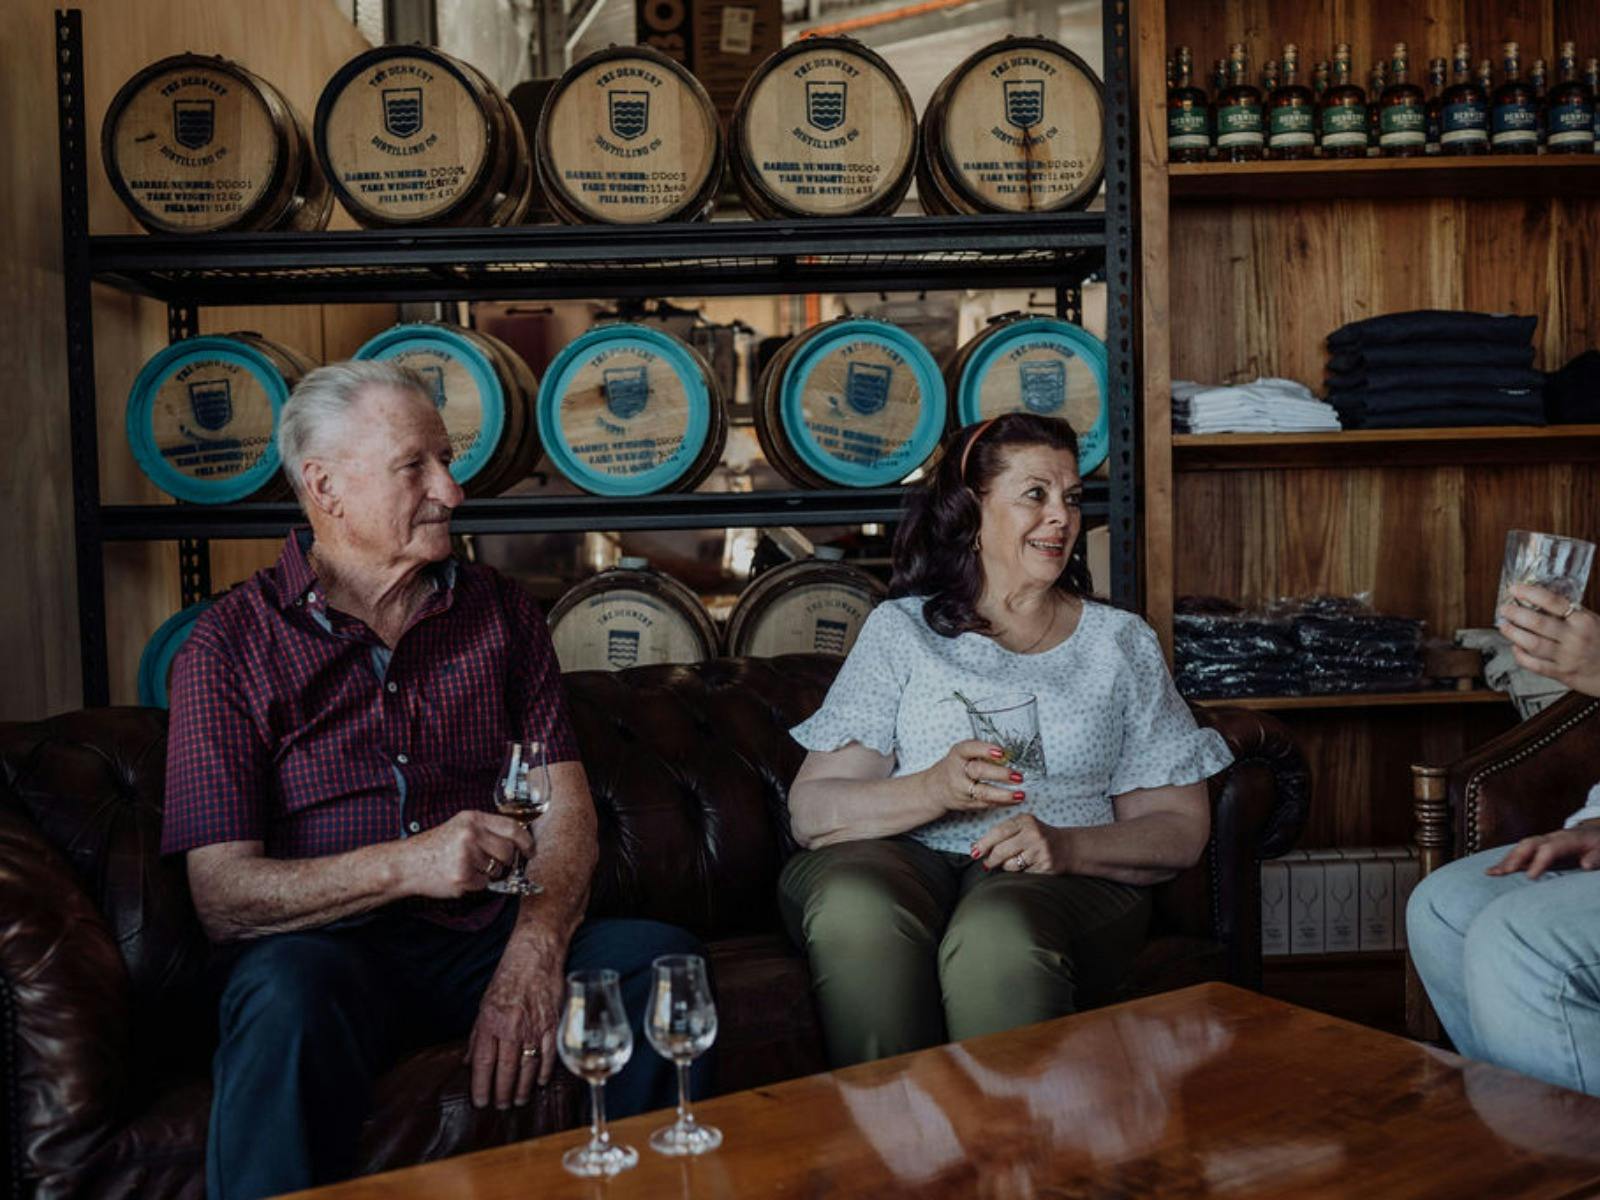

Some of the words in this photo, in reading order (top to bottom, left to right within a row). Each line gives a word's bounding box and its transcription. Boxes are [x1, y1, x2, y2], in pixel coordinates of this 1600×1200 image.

[616, 68, 663, 87] DERWENT
[794, 62, 813, 78] THE
[814, 59, 860, 77] DERWENT
[991, 61, 1010, 78] THE
[1011, 57, 1057, 77] DERWENT
[595, 135, 649, 158] DISTILLING
[792, 127, 846, 149] DISTILLING
